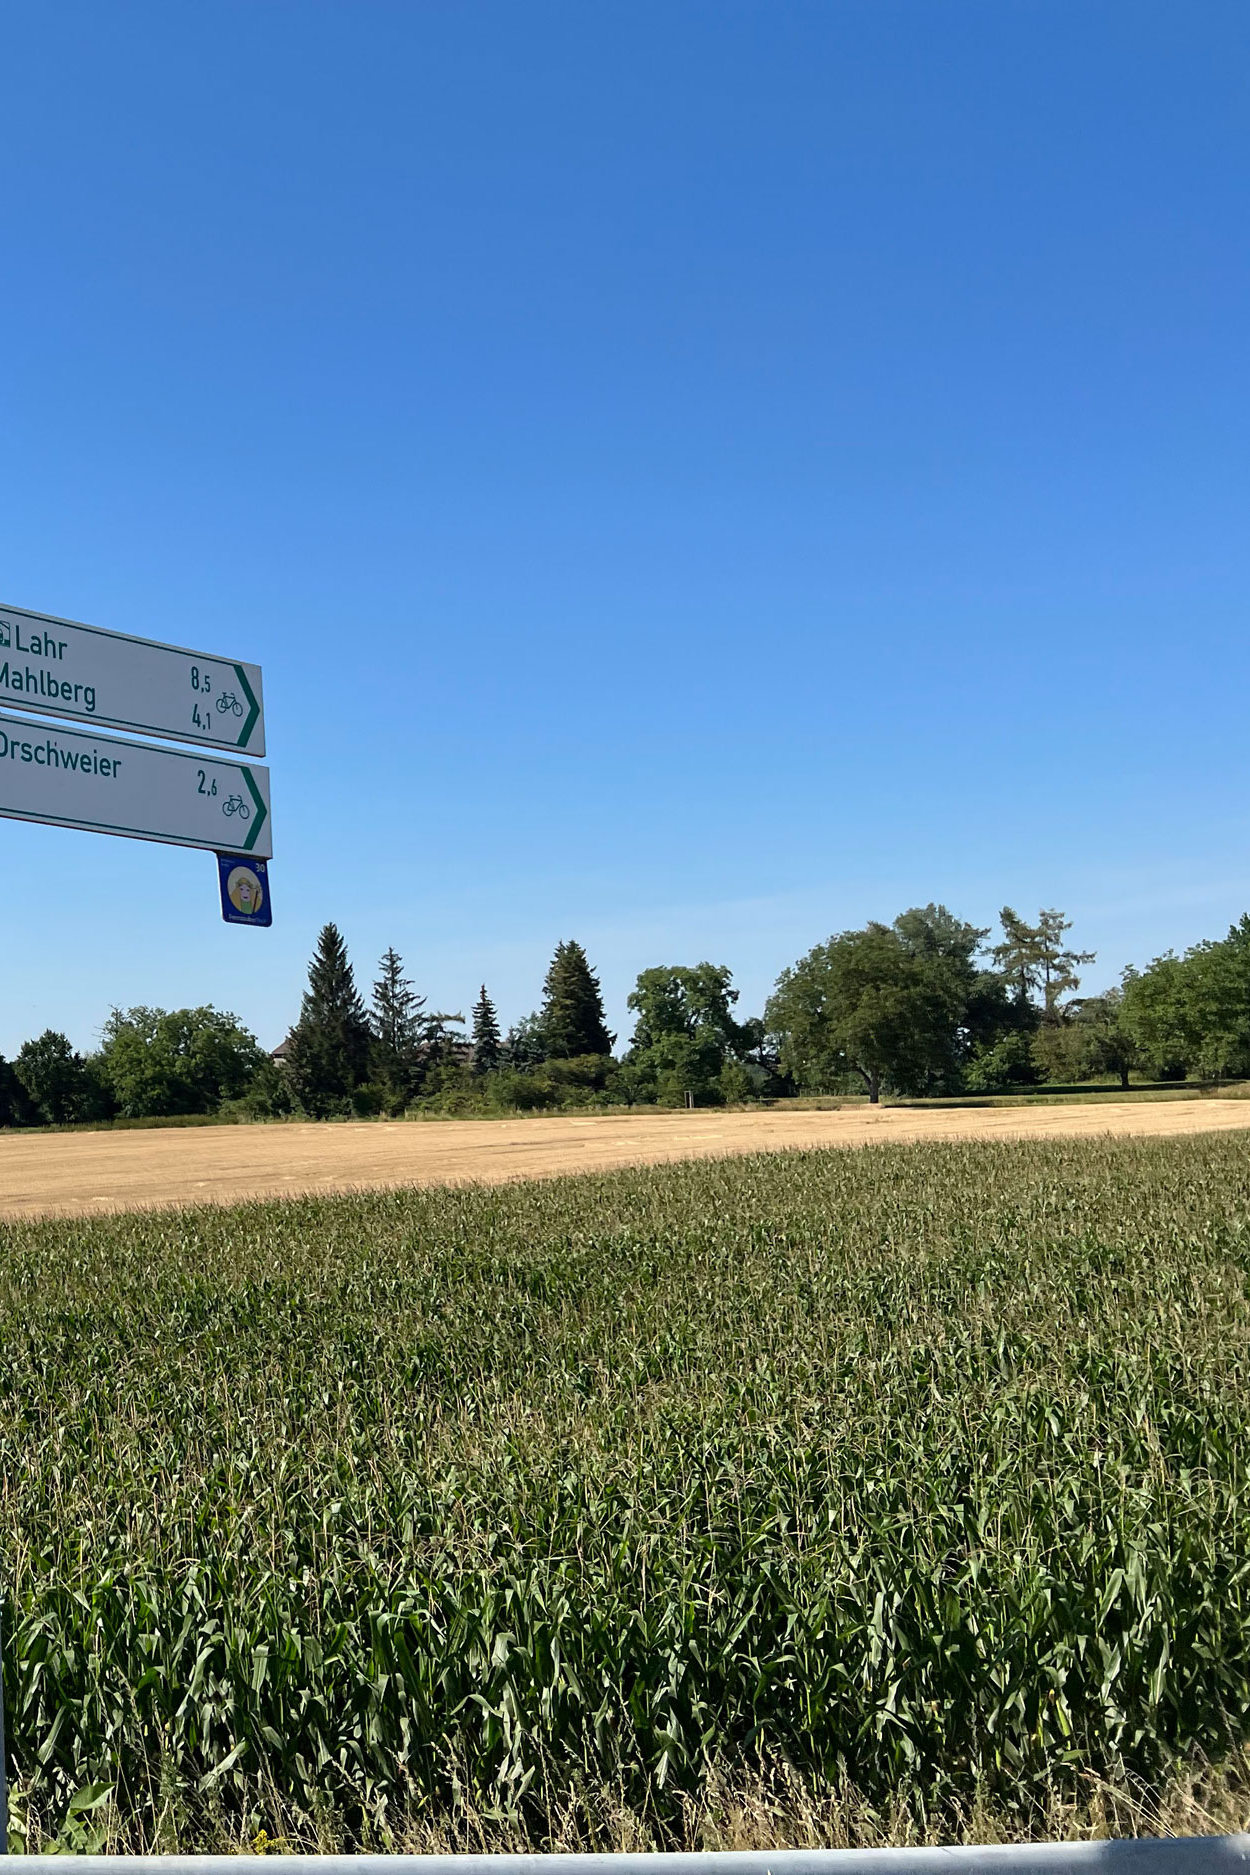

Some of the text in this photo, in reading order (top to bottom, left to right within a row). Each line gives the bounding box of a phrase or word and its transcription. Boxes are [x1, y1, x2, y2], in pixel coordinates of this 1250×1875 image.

[15, 625, 211, 693] Lahr 8,5
[192, 703, 211, 730] 4,1
[197, 769, 217, 797] 2,6
[255, 862, 266, 873] 30
